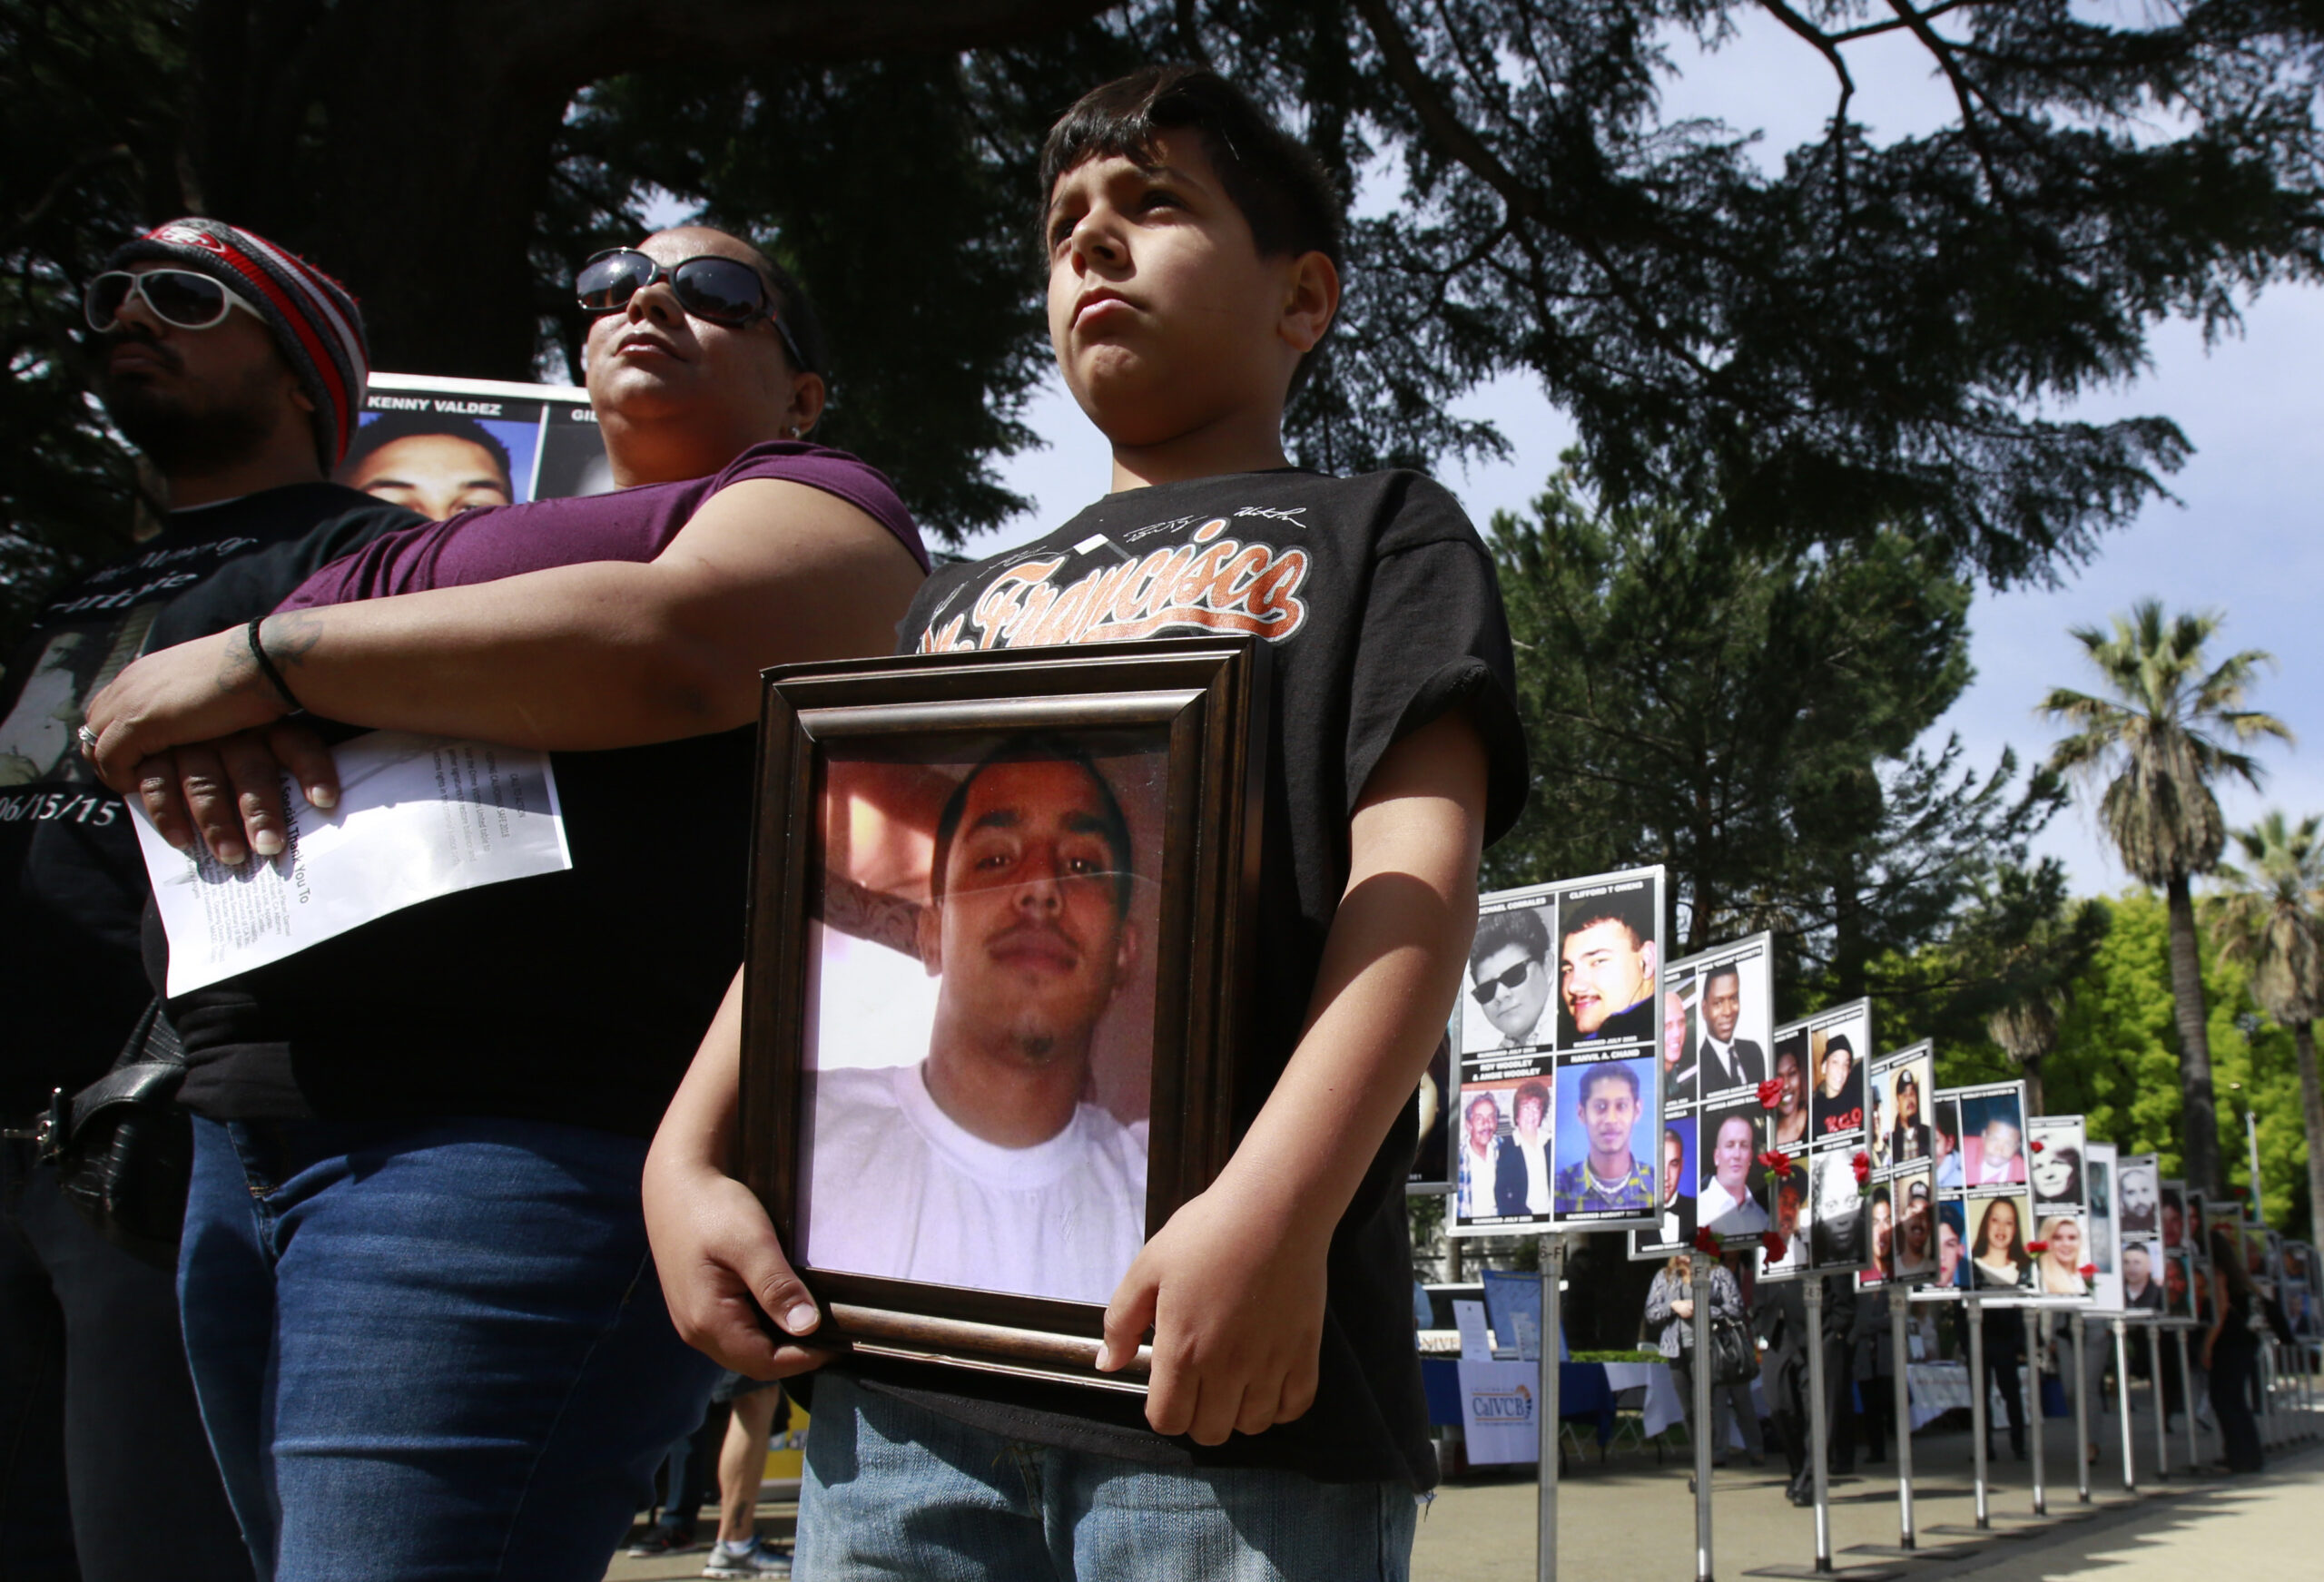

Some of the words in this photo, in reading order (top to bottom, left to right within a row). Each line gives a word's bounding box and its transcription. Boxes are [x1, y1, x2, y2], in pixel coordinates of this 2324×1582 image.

[368, 396, 430, 411] KENNY
[434, 400, 503, 416] VALDEZ
[972, 518, 1307, 643] Francisco
[0, 794, 122, 826] 06/15/15
[281, 786, 296, 826] Special
[289, 827, 303, 863] Thank
[295, 863, 308, 888] You
[299, 887, 310, 903] To
